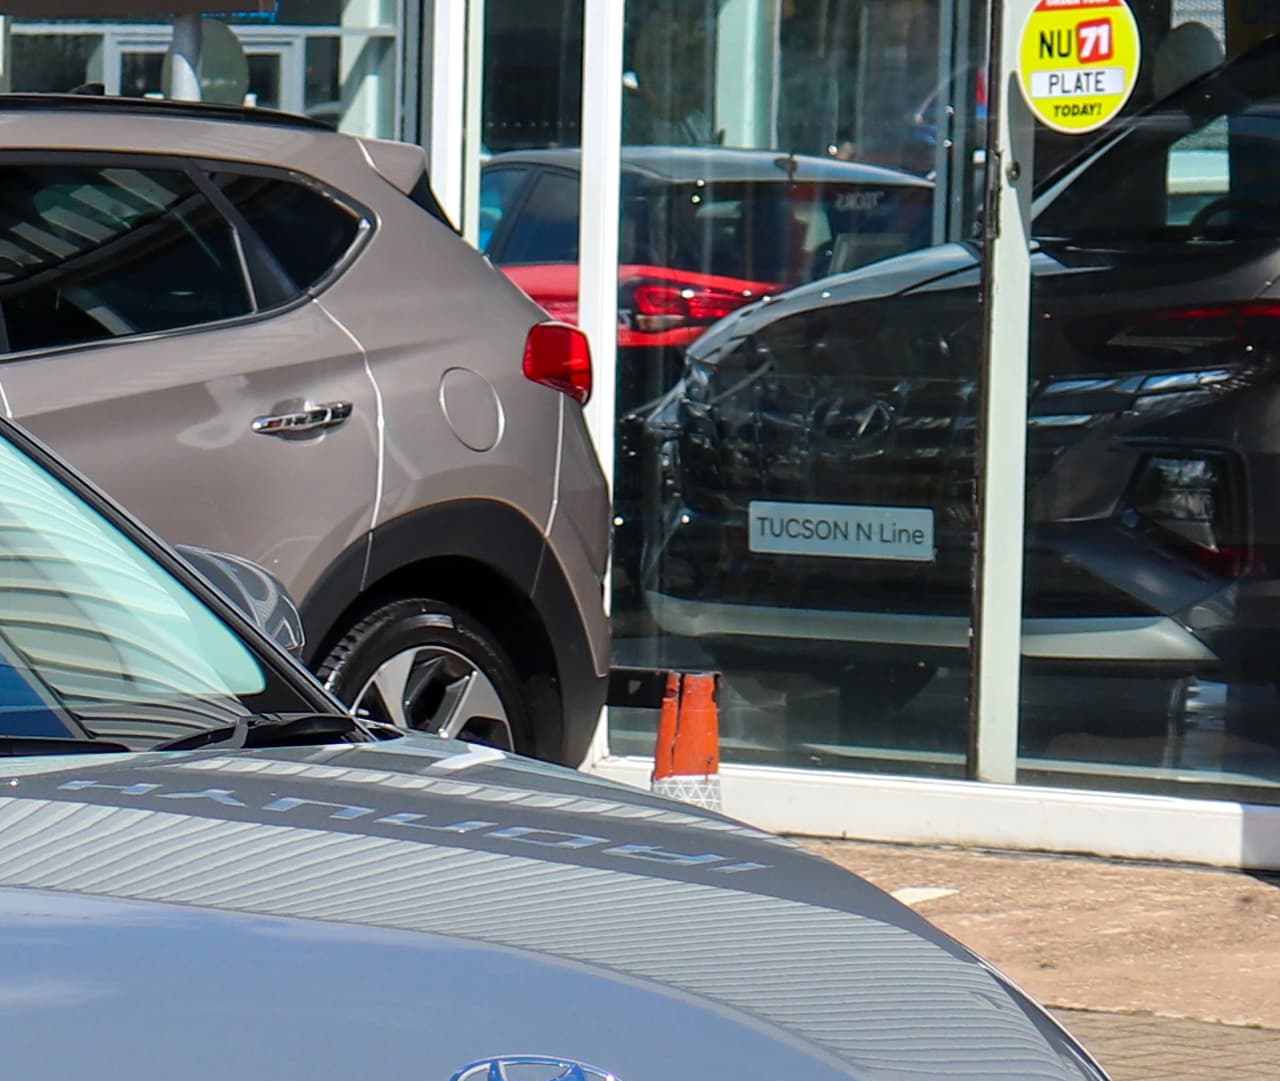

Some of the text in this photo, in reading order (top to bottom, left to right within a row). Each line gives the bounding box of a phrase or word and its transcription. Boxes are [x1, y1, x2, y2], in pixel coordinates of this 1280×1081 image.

[1048, 71, 1105, 94] PLATE
[1053, 103, 1102, 117] TODAY!
[756, 516, 925, 545] TUCSON N Line
